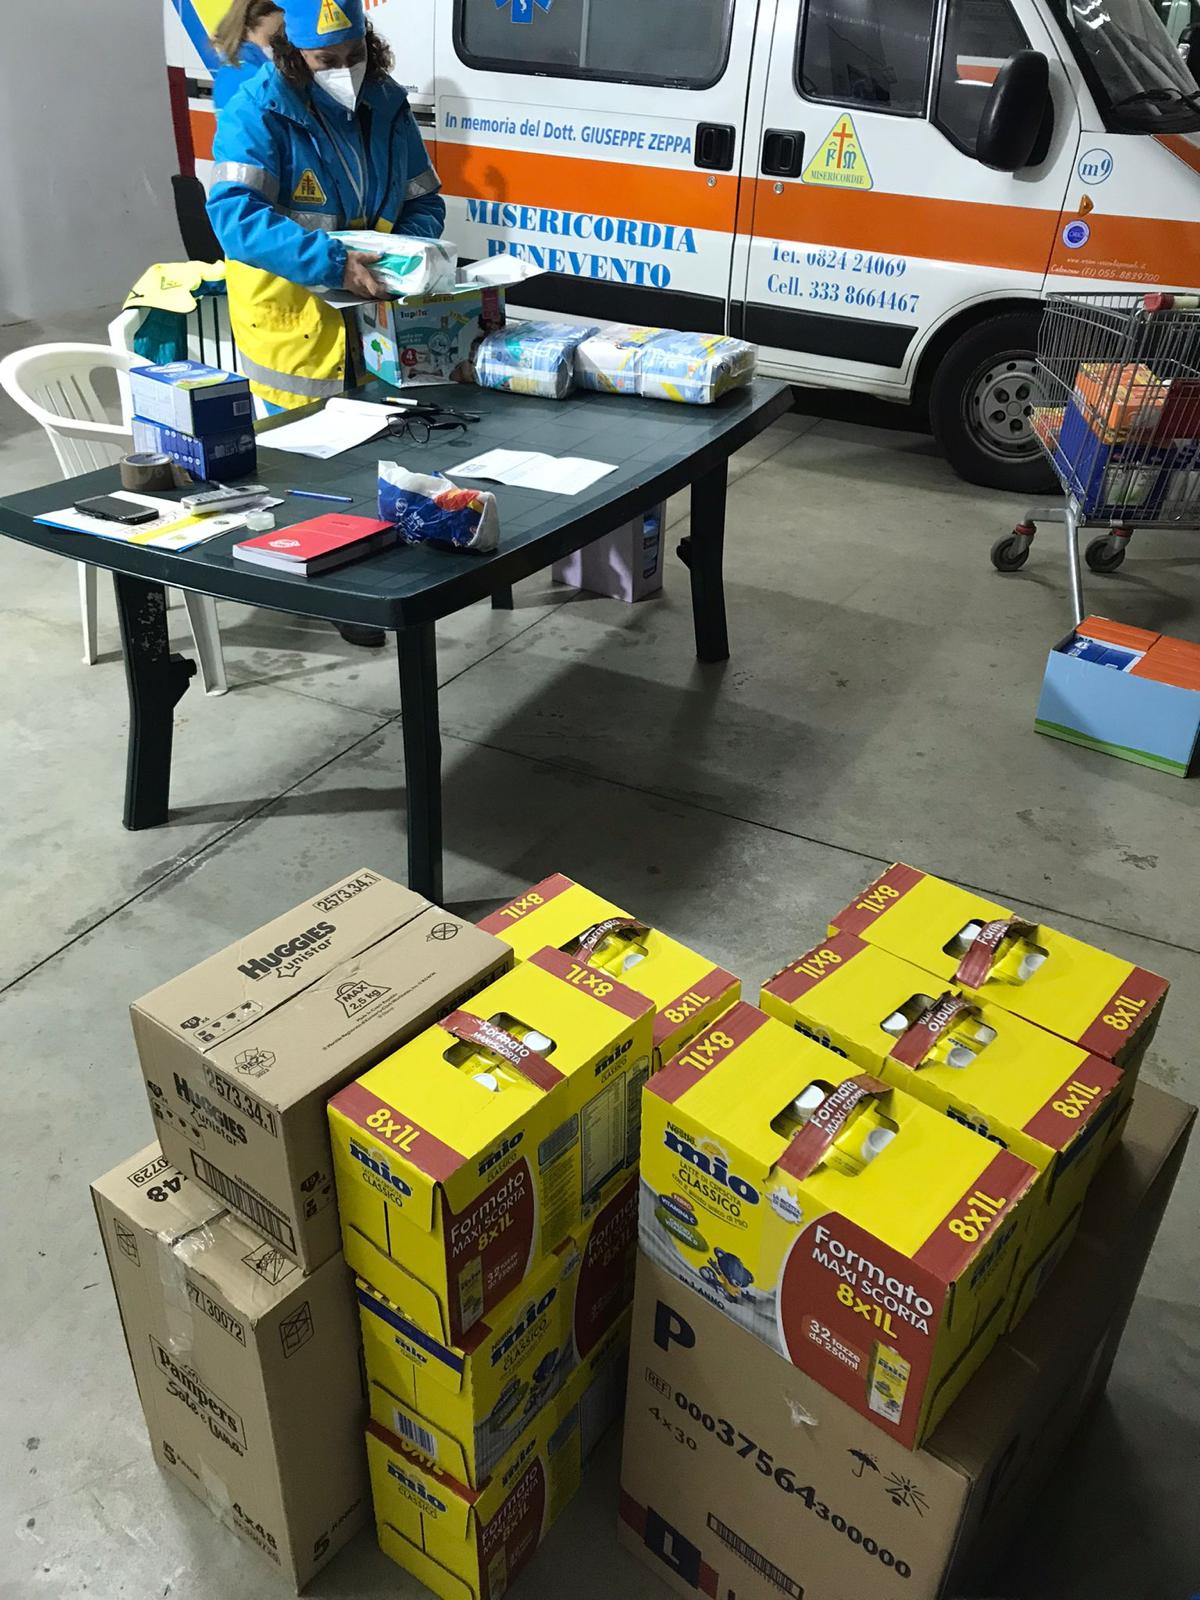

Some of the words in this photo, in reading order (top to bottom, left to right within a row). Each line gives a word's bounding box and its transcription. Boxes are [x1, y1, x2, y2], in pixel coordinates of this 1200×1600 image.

[445, 112, 457, 129] In
[461, 117, 516, 135] memoria
[519, 118, 540, 137] del
[544, 122, 576, 142] Dott.
[581, 126, 645, 150] GIUSEPPE
[648, 132, 692, 155] ZEPPA
[810, 169, 866, 185] MISERICORDIE
[1081, 158, 1111, 177] m9
[465, 199, 698, 255] MISERICORDIA
[486, 238, 671, 290] BENEVENTO
[771, 241, 800, 264] Tel.
[806, 249, 848, 271] 0824
[852, 253, 907, 278] 24069
[767, 273, 803, 298] Cell.
[808, 280, 840, 302] 333
[844, 285, 921, 314] 8664467
[316, 874, 378, 912] 2573.34.1
[500, 893, 544, 919] 8x1L
[856, 884, 901, 914] 8x1L
[237, 921, 337, 980] HUGGIES
[284, 937, 333, 970] unistar
[581, 918, 620, 950] Formato
[565, 963, 614, 997] 8x1L
[793, 949, 842, 981] 8x1L
[341, 984, 369, 1003] MAX
[349, 997, 367, 1011] 2,5
[367, 989, 382, 1002] kg
[664, 991, 711, 1024] 8x1L
[1102, 996, 1147, 1031] 8x1L
[595, 1039, 633, 1077] mio
[679, 1030, 735, 1071] 8x1L
[810, 1081, 858, 1128] Formato
[1051, 1081, 1102, 1120] 8x1L
[366, 1108, 421, 1152] 8x1L
[824, 1110, 847, 1136] MAXI
[350, 1143, 412, 1197] mio
[479, 1131, 525, 1177] mio
[487, 1153, 518, 1183] CLASSICO
[664, 1131, 760, 1205] mio
[362, 1172, 403, 1208] CLASSICO
[679, 1169, 741, 1218] CLASSICO
[680, 1161, 699, 1178] LATTE
[700, 1173, 708, 1184] DI
[709, 1180, 742, 1208] CRESCITA
[451, 1171, 525, 1244] Formato
[452, 1223, 483, 1258] MAXI
[484, 1186, 526, 1230] SCORTA
[661, 1197, 689, 1220] VITAMINA
[948, 1190, 1008, 1243] 8x1L
[478, 1212, 515, 1251] 8x1L
[815, 1224, 934, 1317] Formato
[812, 1247, 858, 1286] MAXI
[861, 1280, 930, 1336] SCORTA
[836, 1283, 899, 1339] 8x1L
[207, 1299, 243, 1342] 30072
[491, 1287, 557, 1368] mio
[653, 1300, 697, 1353] P
[394, 1336, 428, 1364] mio
[503, 1318, 548, 1371] CLASSICO
[808, 1332, 823, 1346] da
[825, 1342, 859, 1371] 250ml
[810, 1320, 831, 1342] 32
[832, 1338, 861, 1364] tazze
[157, 1346, 238, 1433] Pampers
[166, 1380, 199, 1416] Sole
[648, 1371, 671, 1397] REF
[648, 1406, 698, 1452] 4x30
[163, 1440, 177, 1465] 5
[502, 1439, 536, 1487] mio
[387, 1463, 447, 1513] mio
[399, 1486, 439, 1519] CLASSICO
[481, 1465, 539, 1546] Formato
[675, 1391, 912, 1579] 00037564300000
[313, 1531, 330, 1562] 5
[663, 1530, 681, 1566] L
